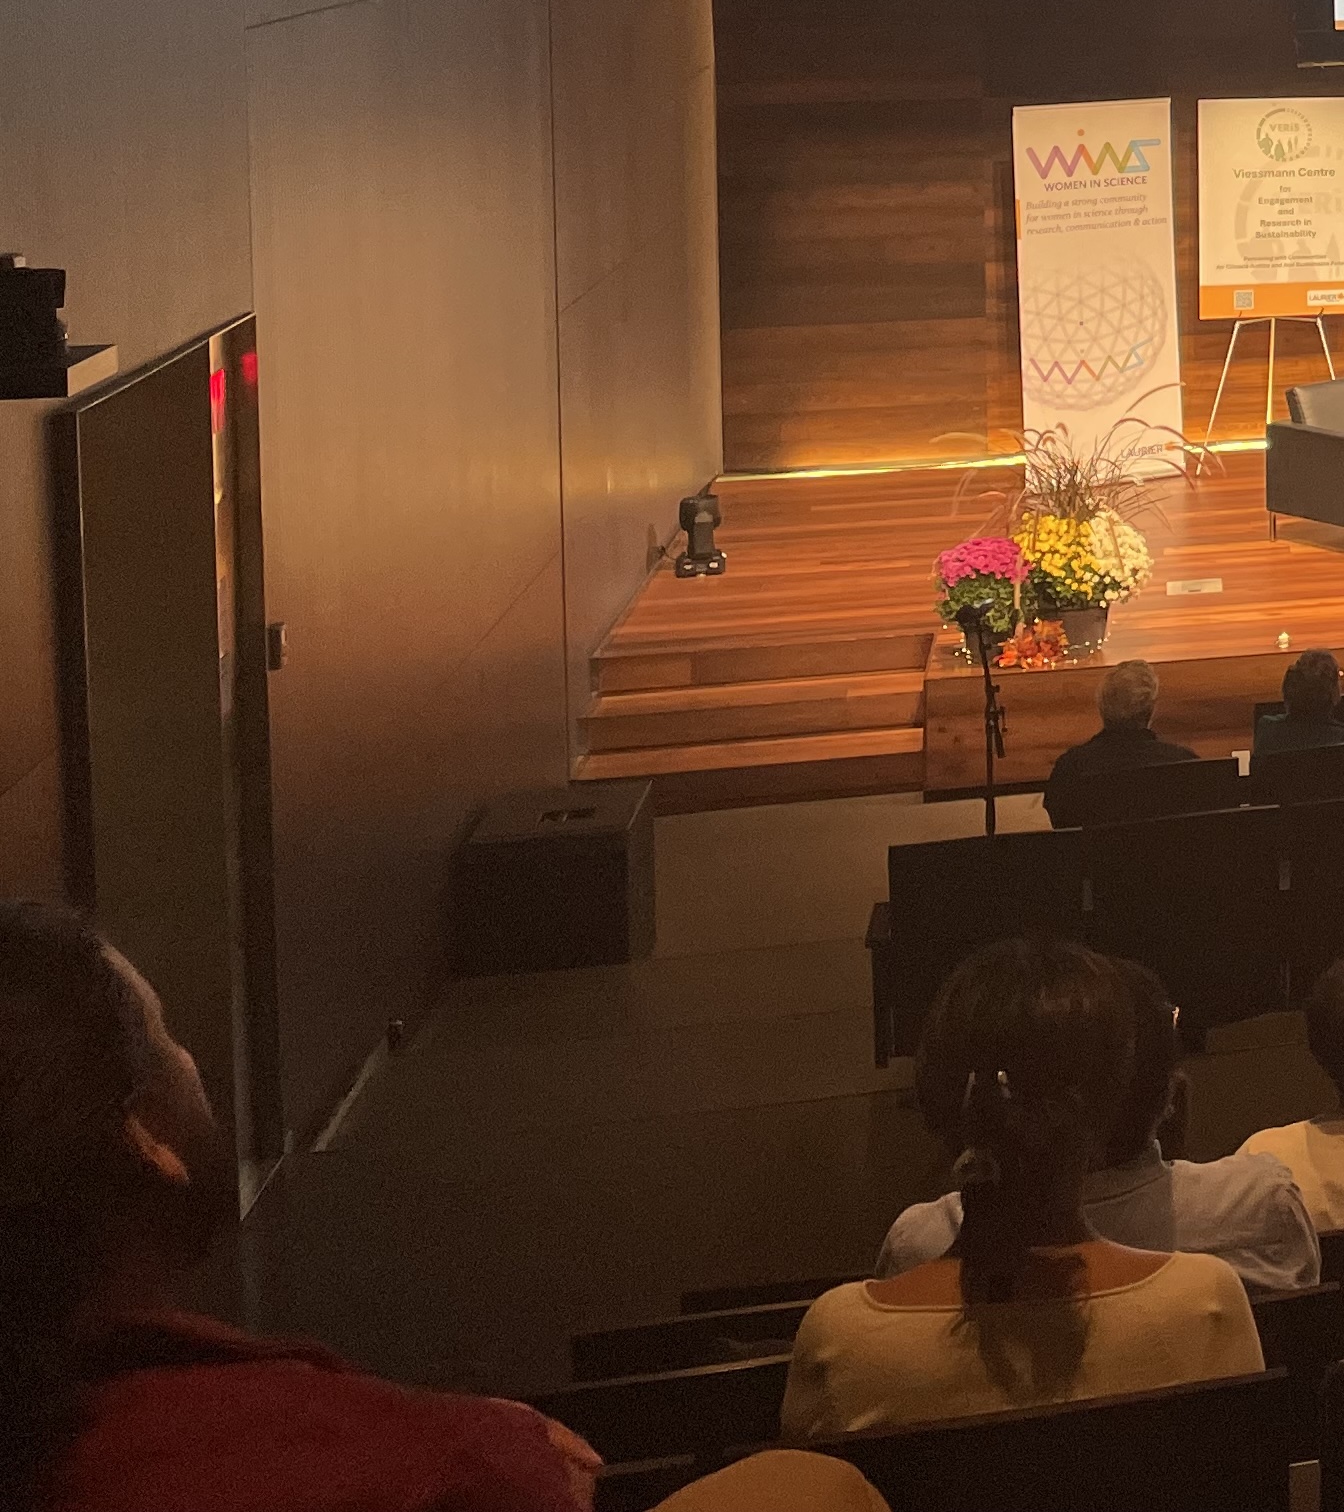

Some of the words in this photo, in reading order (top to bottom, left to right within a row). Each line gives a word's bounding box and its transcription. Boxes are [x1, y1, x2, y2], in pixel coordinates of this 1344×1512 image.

[1232, 169, 1296, 179] Viessmann
[1297, 167, 1336, 178] Centre
[1044, 180, 1087, 192] WOMEN
[1090, 179, 1101, 188] IN
[1104, 176, 1148, 187] SCIENCE
[1025, 199, 1062, 211] Building
[1072, 198, 1098, 207] strong
[1099, 193, 1147, 205] community
[1258, 196, 1313, 206] Engagement
[1025, 213, 1039, 225] for
[1041, 213, 1071, 222] women
[1073, 211, 1082, 219] in
[1083, 209, 1112, 219] science
[1114, 205, 1148, 217] through
[1277, 207, 1295, 215] and
[1133, 218, 1141, 226] &
[1142, 217, 1167, 226] action
[1260, 219, 1302, 227] Research
[1303, 218, 1312, 226] in
[1255, 230, 1317, 239] Sustainability
